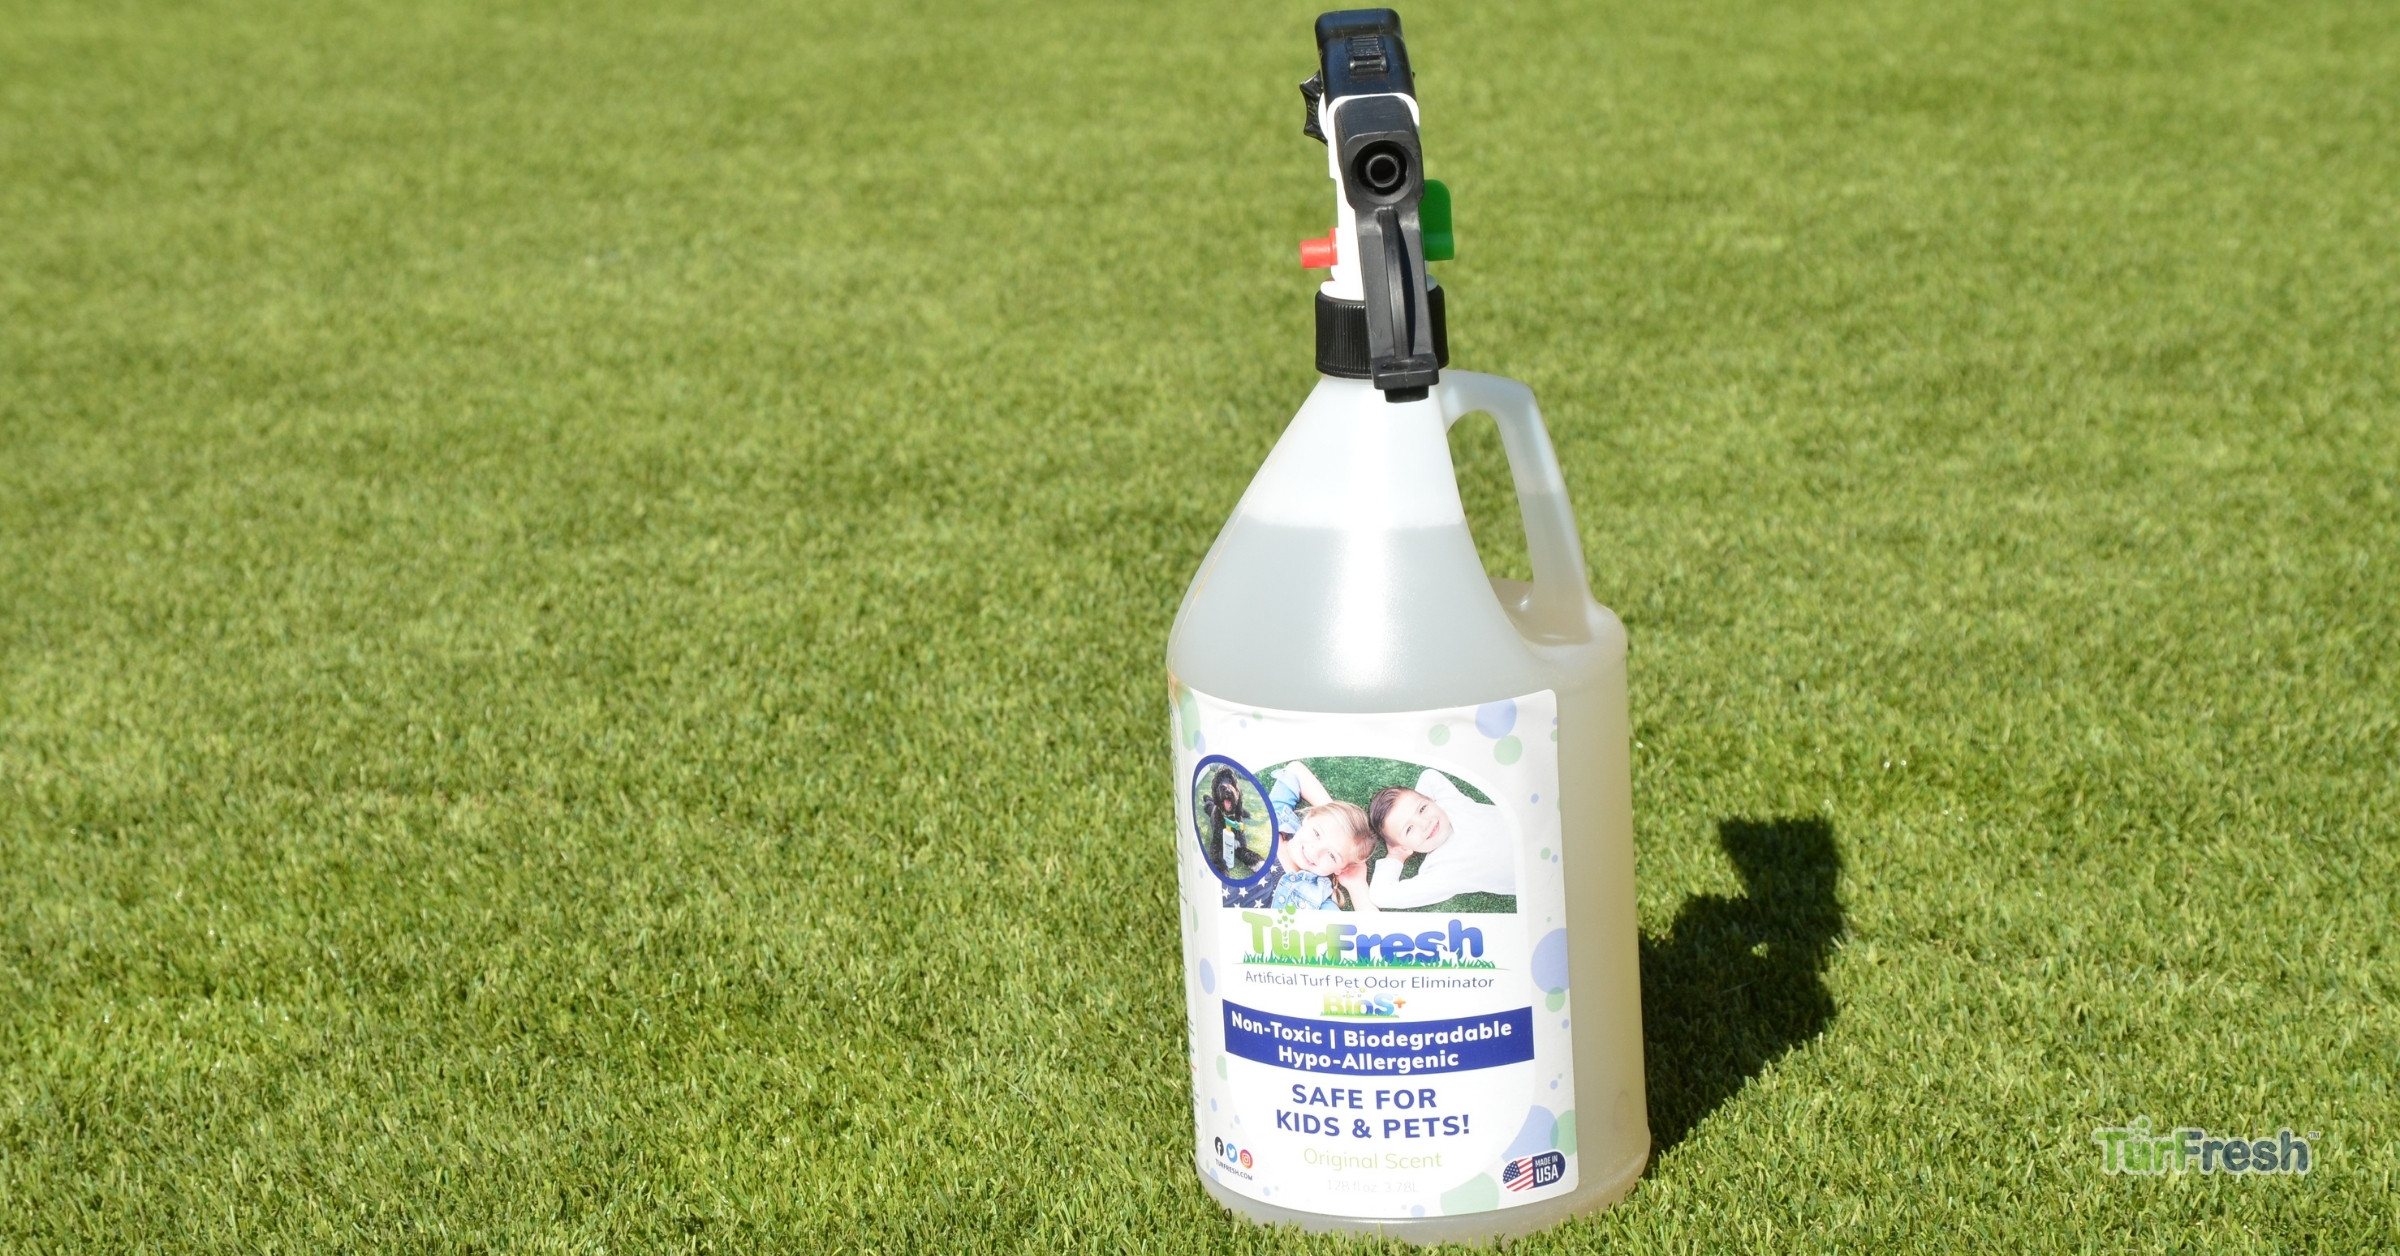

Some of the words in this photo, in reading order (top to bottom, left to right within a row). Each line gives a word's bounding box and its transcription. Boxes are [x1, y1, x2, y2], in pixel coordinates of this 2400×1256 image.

[1245, 970, 1298, 986] Artificial
[1300, 974, 1333, 988] Turf
[1335, 975, 1359, 989] Pet
[1364, 975, 1407, 989] Odor
[1411, 976, 1496, 989] Eliminator
[1231, 1010, 1323, 1045] Non-Toxic
[1343, 1021, 1513, 1051] Biodegradable
[1278, 1045, 1459, 1075] Hypo-Allergenic
[1292, 1083, 1364, 1110] SAFE
[1375, 1088, 1437, 1110] FOR
[1276, 1109, 1341, 1137] KIDS
[1352, 1118, 1372, 1139] &
[1383, 1114, 1470, 1139] PETS!
[1303, 1148, 1379, 1172] Original
[1385, 1152, 1443, 1170] Scent
[1535, 1156, 1552, 1168] MADE
[1551, 1154, 1559, 1163] IN
[1536, 1163, 1559, 1184] USA
